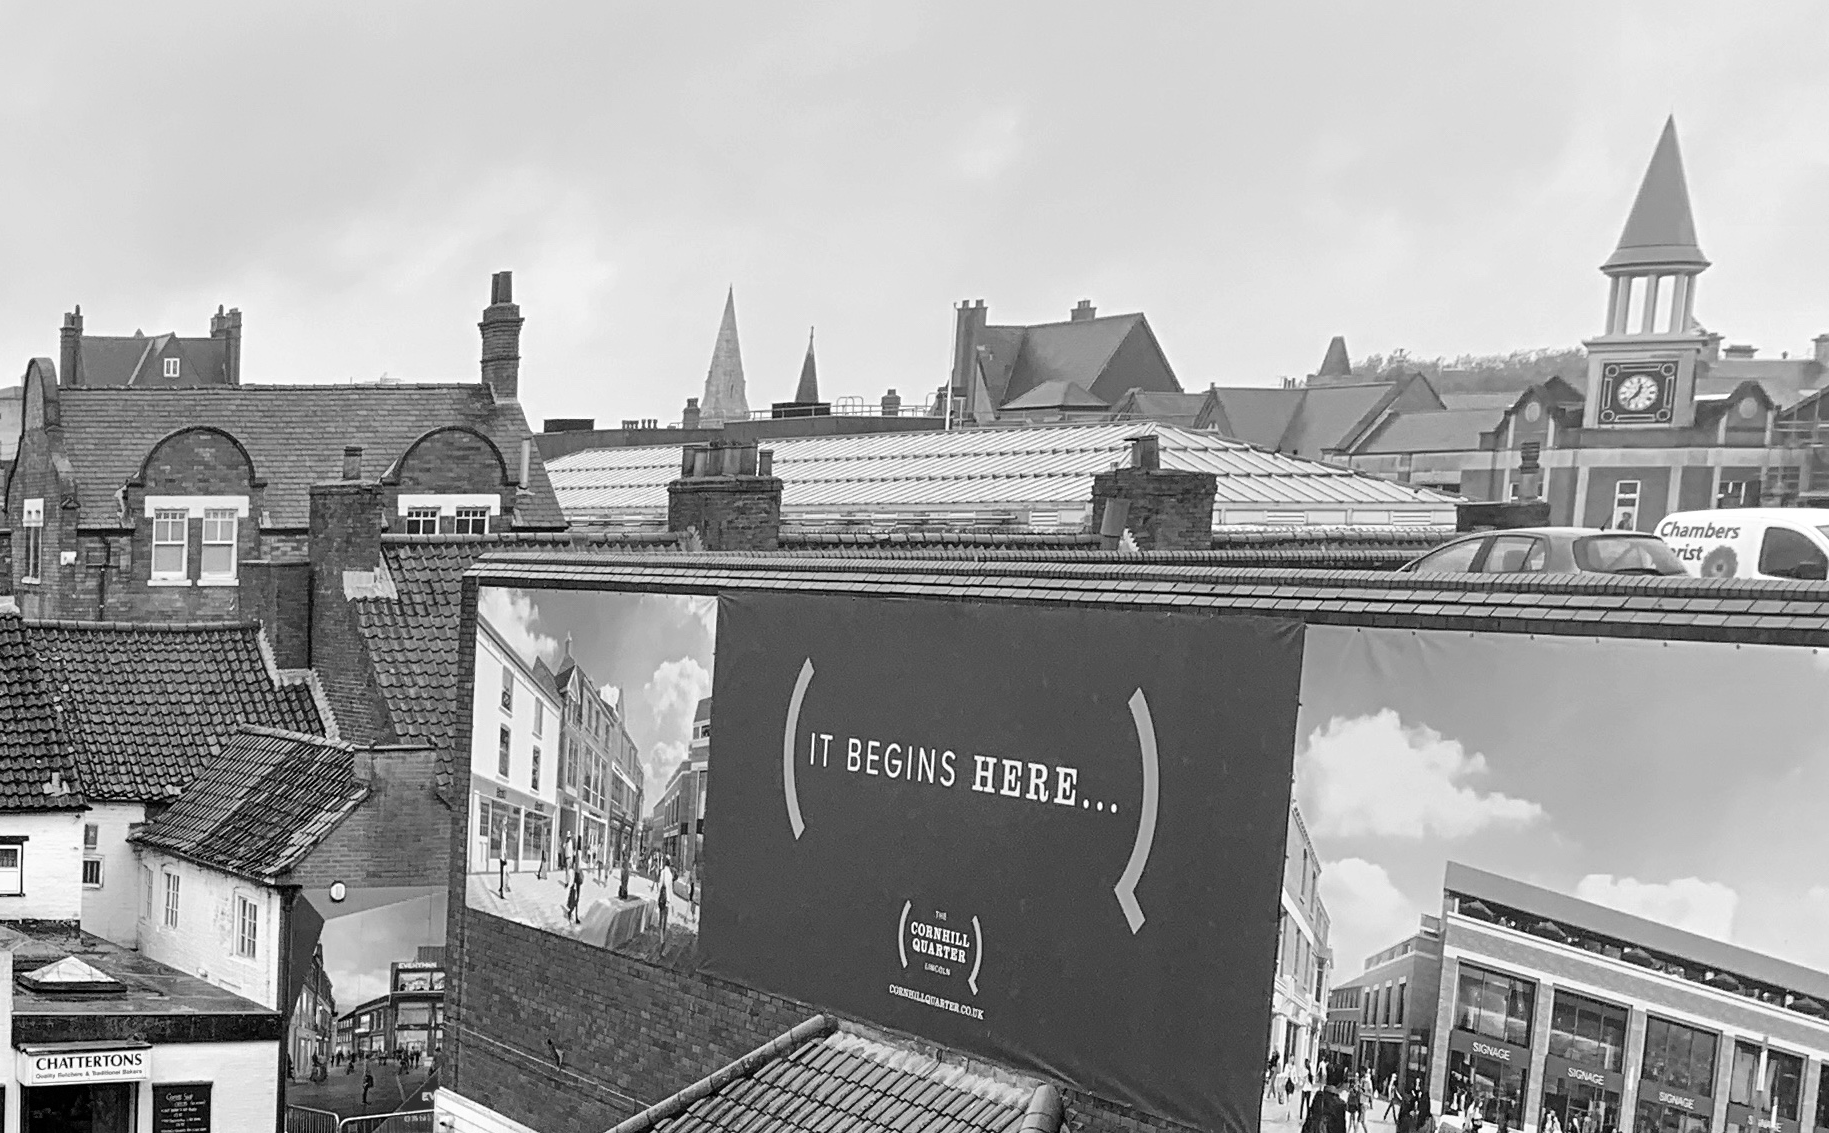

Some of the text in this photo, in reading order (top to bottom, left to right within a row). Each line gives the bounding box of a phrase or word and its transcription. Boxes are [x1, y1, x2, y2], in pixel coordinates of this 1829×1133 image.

[1661, 521, 1740, 539] Chambers
[1671, 544, 1703, 560] rist
[809, 732, 1118, 813] IT BEGINS HERE...
[935, 910, 947, 921] THE
[910, 921, 970, 948] CORNHILL
[911, 938, 967, 964] QUARTER
[924, 962, 951, 976] LINCOLN
[889, 984, 985, 1020] CORNHILLQUARTER.CO.UK
[1472, 1041, 1511, 1061] SIGNAGE
[36, 1053, 143, 1070] CHATTERTONS
[1567, 1066, 1605, 1086] SIGNAGE
[1658, 1091, 1695, 1110] SIGNAGE
